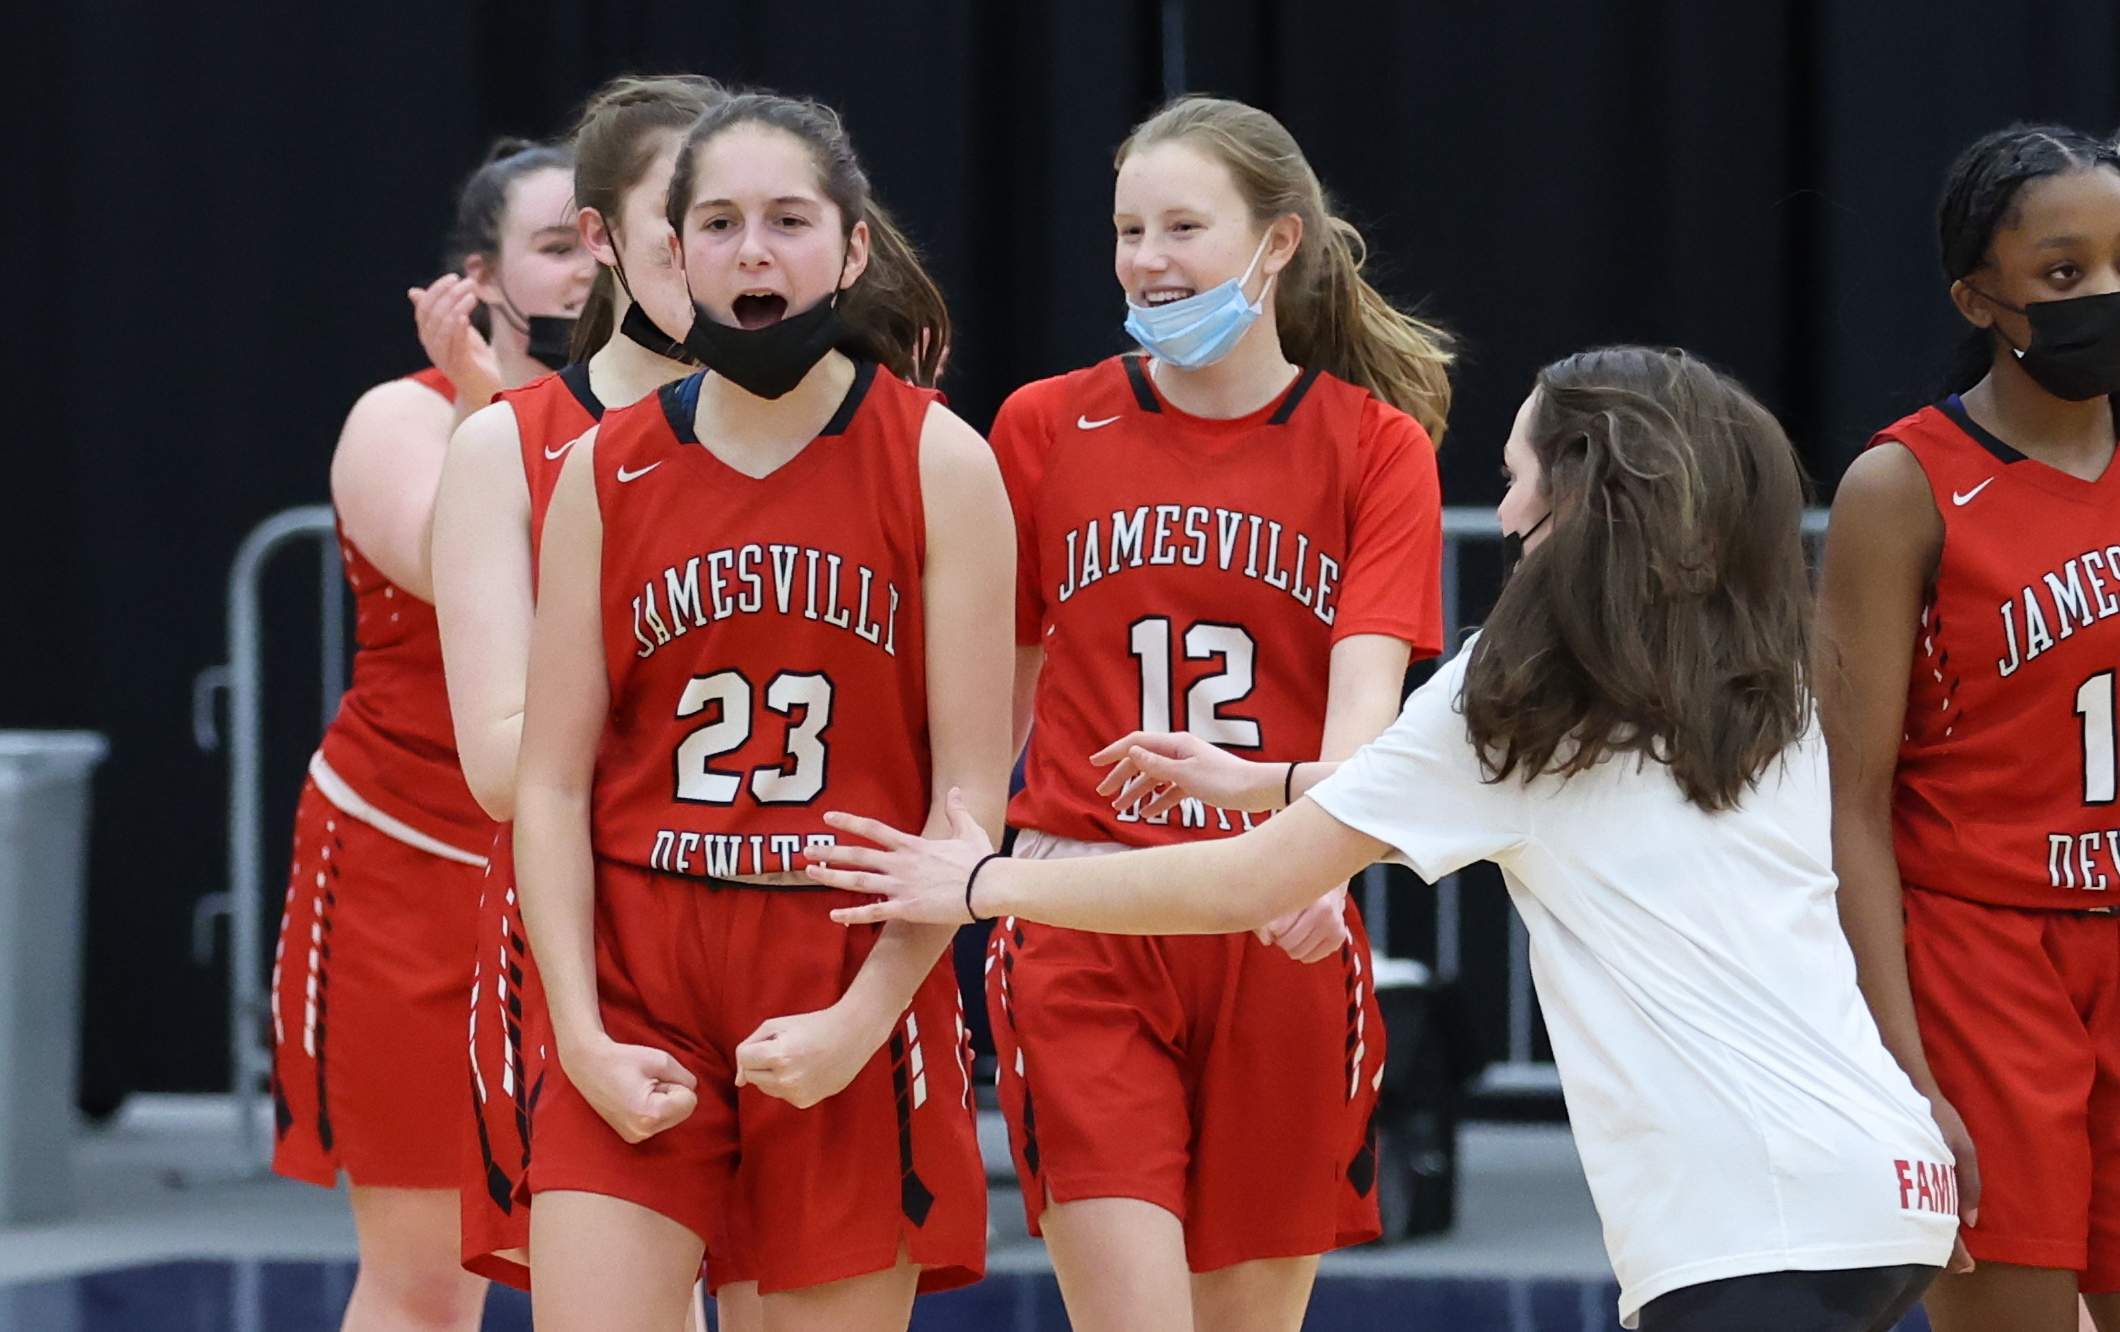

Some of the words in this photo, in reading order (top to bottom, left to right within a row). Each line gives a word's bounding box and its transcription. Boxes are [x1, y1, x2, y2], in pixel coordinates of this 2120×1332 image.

[1058, 504, 1339, 626] JAMESVILLE
[674, 668, 835, 805] 23
[1129, 615, 1263, 749] 12
